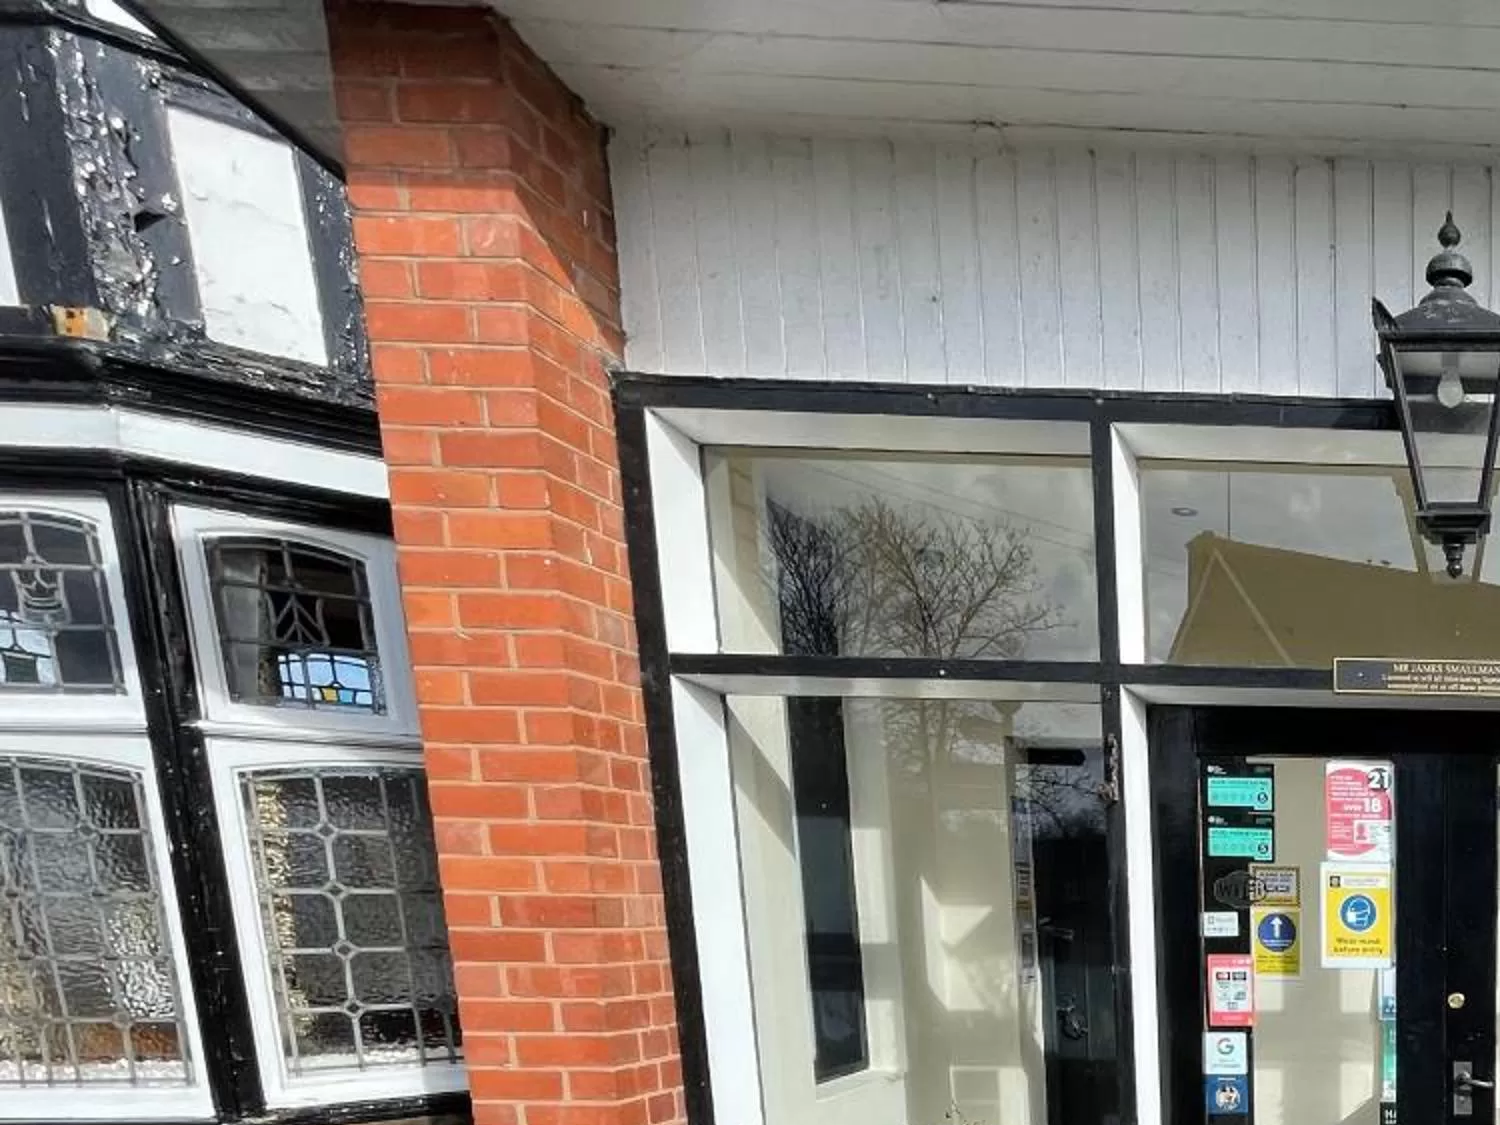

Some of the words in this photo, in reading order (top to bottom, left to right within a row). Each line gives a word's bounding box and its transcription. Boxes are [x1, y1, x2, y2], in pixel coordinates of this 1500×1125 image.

[1411, 663, 1443, 673] JAMES
[1368, 771, 1389, 788] 21
[1364, 798, 1382, 813] 18
